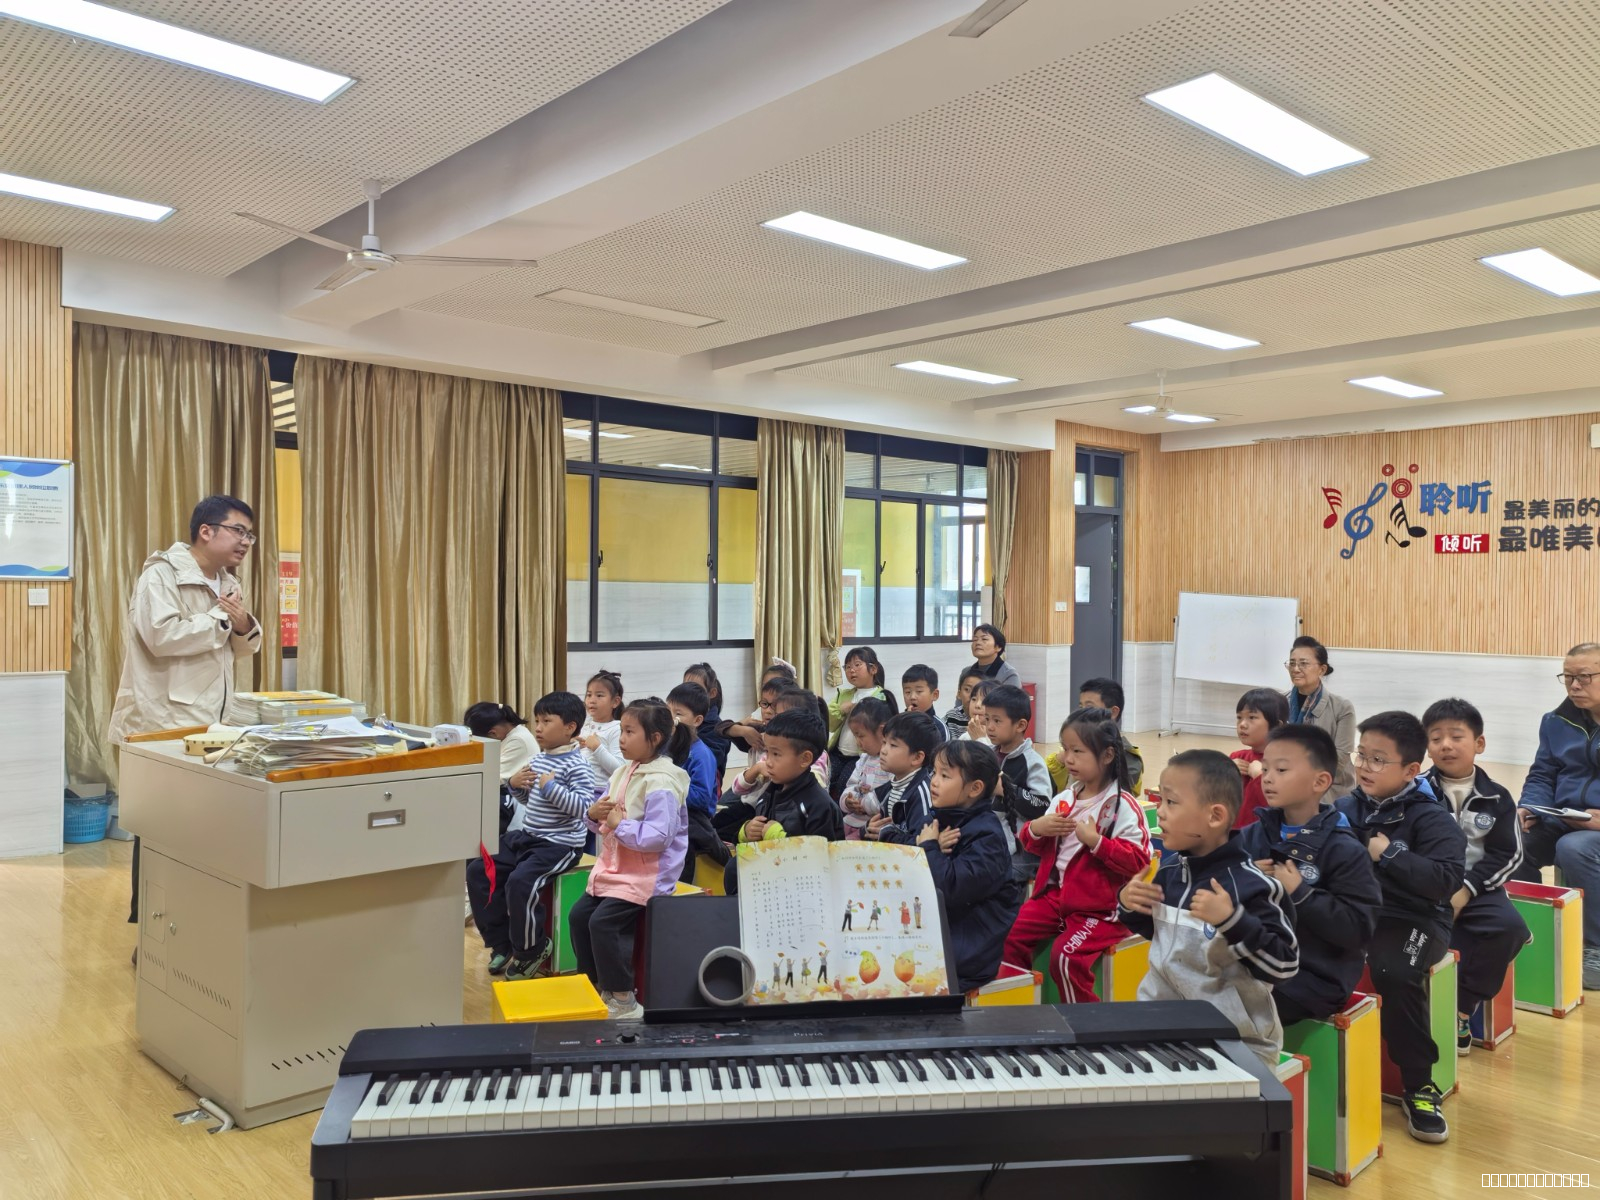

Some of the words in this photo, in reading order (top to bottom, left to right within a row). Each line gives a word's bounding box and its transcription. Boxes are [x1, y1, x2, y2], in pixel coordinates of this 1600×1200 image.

[1419, 480, 1492, 516] 聆听
[1503, 497, 1600, 520] 最美丽的
[1441, 534, 1482, 552] 倾听
[1498, 523, 1600, 552] 最唯美
